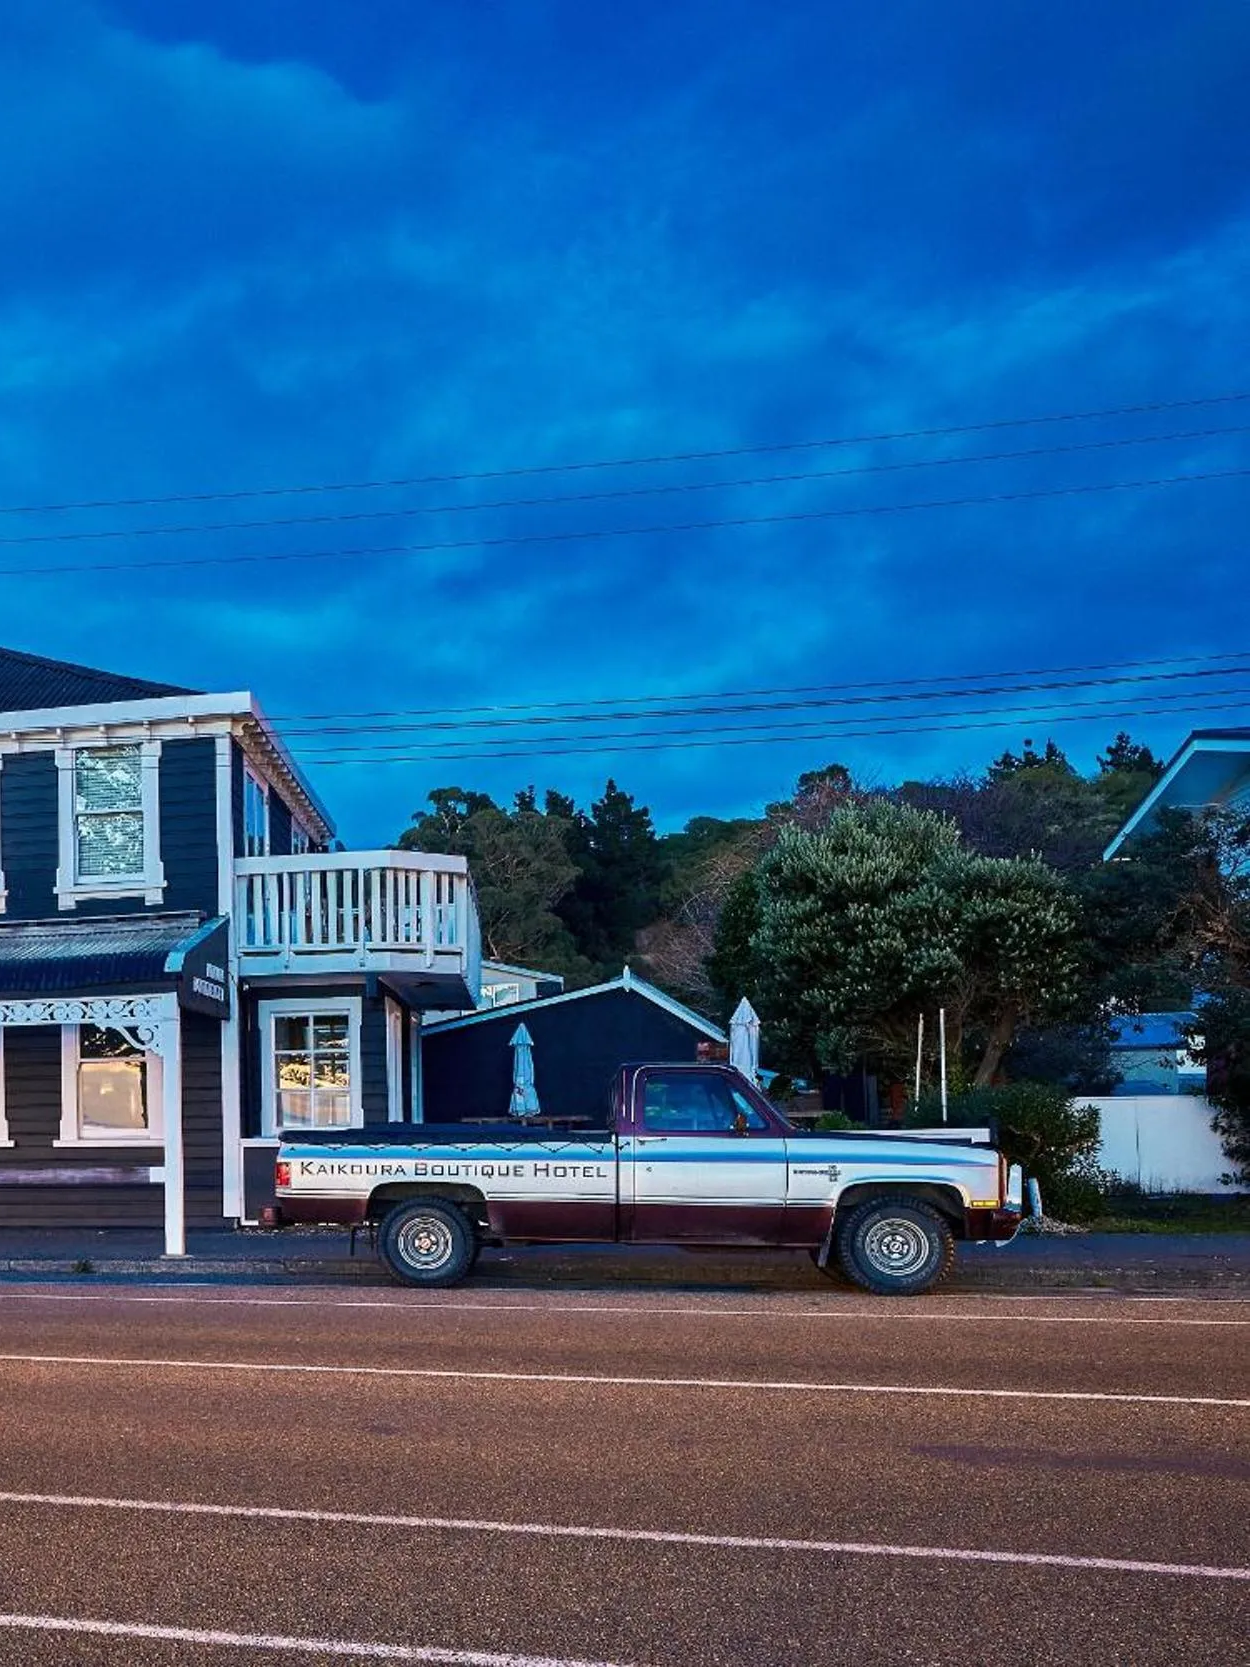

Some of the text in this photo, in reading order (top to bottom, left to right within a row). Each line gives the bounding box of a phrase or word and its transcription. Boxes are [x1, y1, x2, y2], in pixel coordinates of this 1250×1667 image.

[301, 1161, 607, 1179] KAIKOURA BOUTIQUE HOTEL
